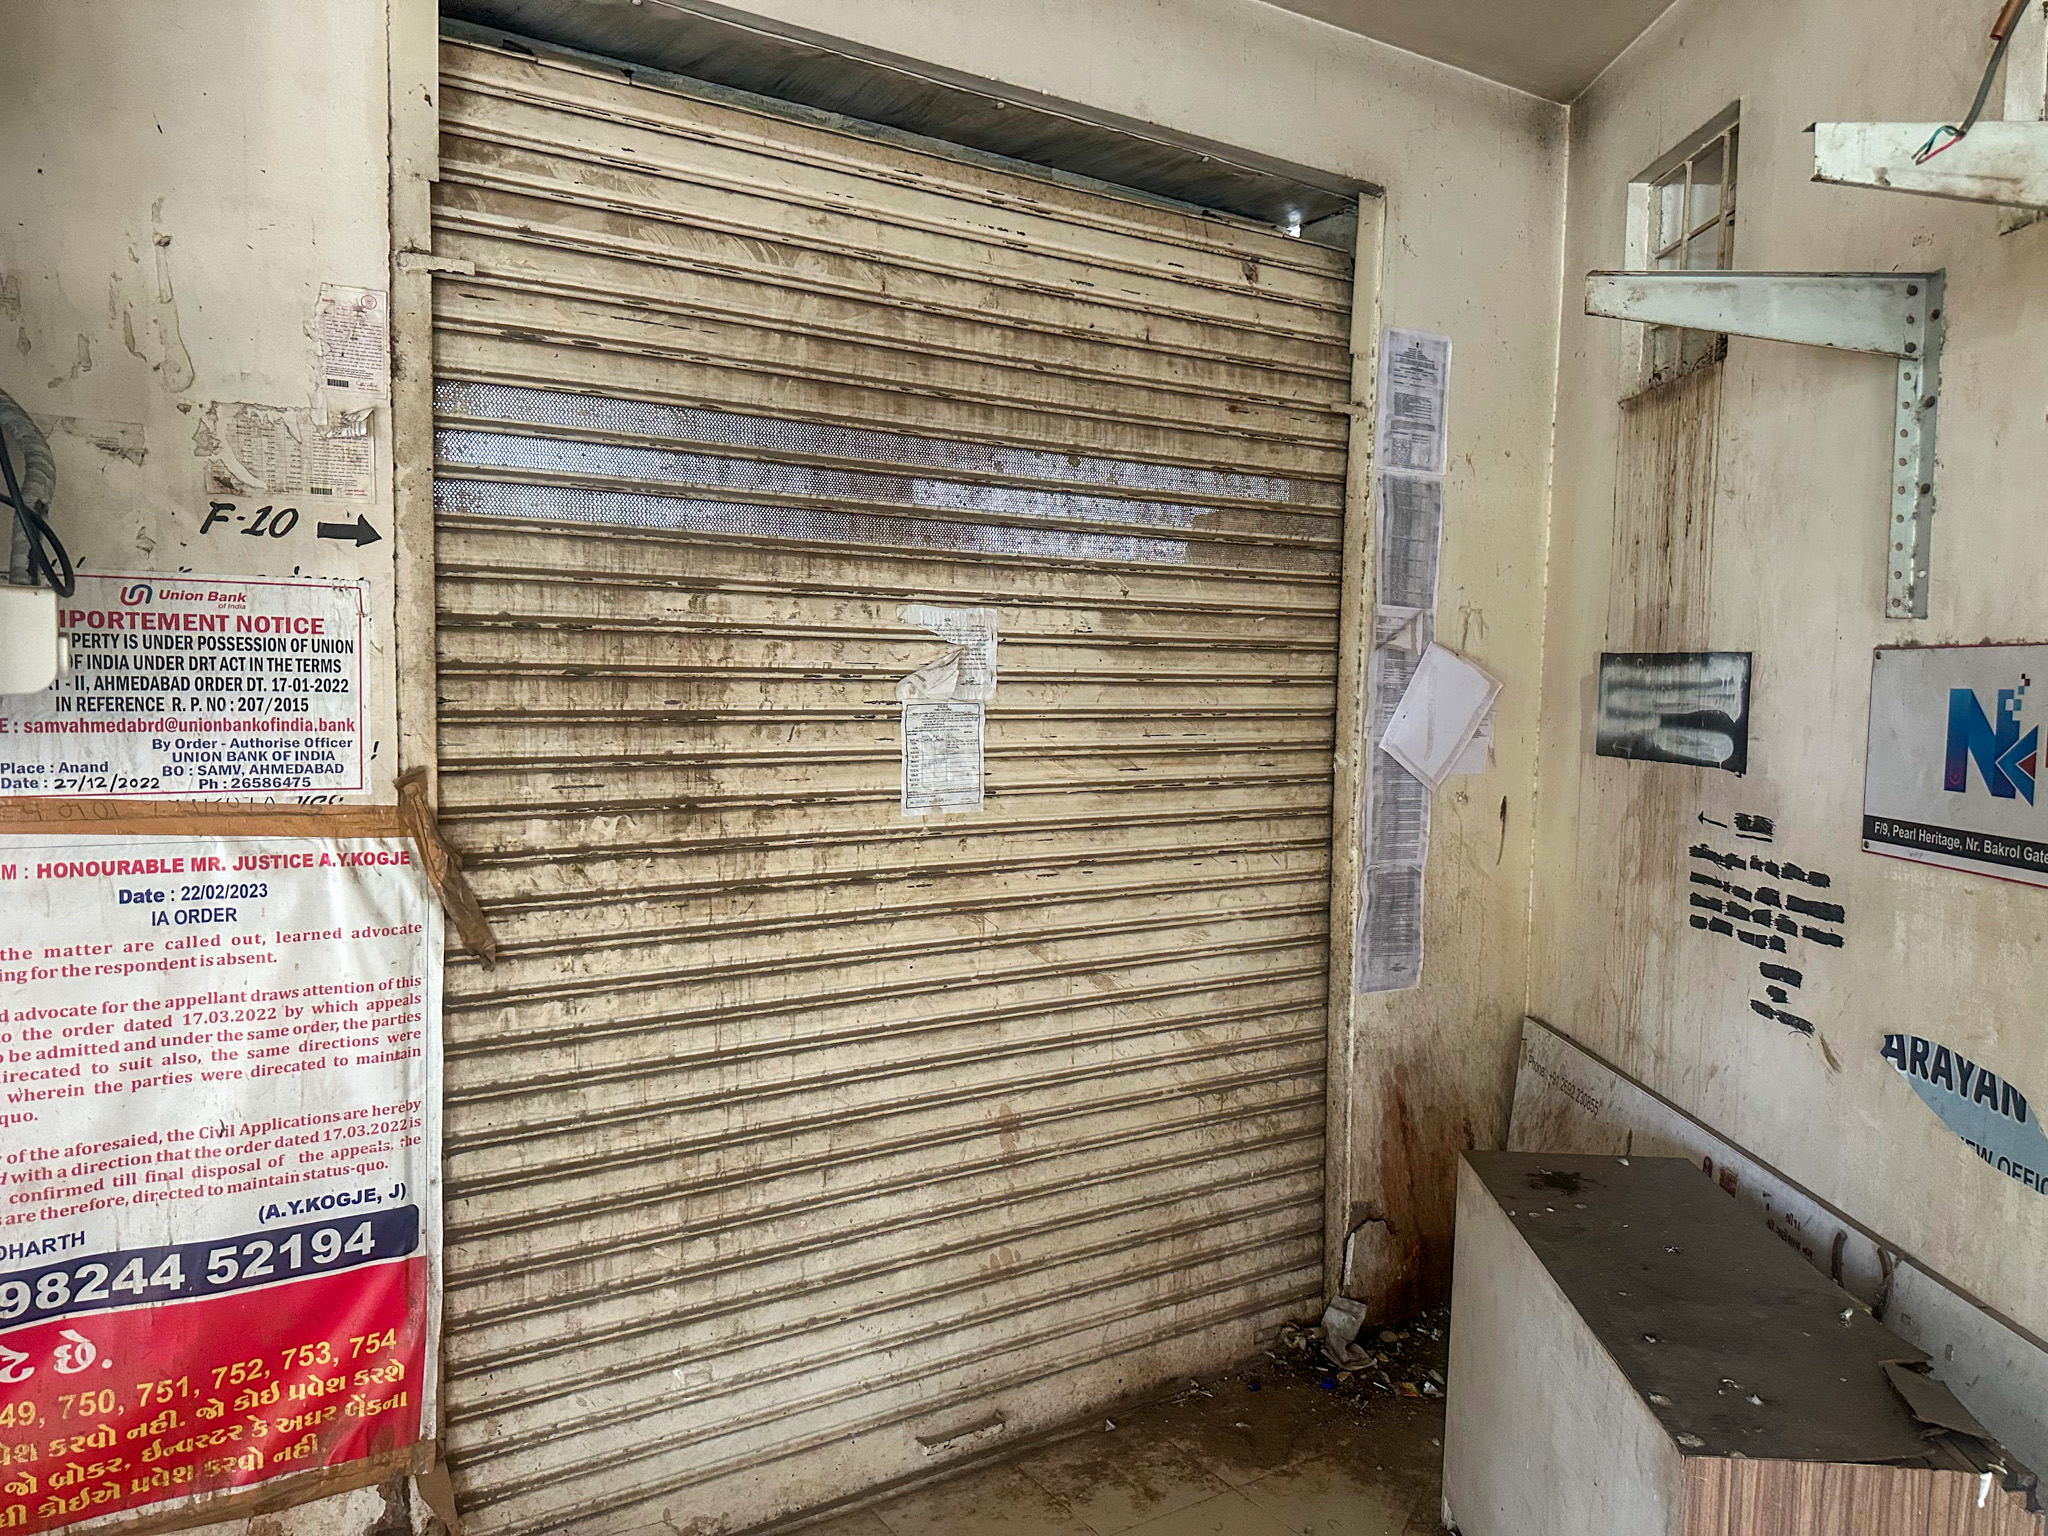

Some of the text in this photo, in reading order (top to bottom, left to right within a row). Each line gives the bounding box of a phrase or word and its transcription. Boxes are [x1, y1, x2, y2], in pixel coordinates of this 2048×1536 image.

[200, 501, 298, 538] F-10
[159, 590, 247, 602] Union Bank
[237, 615, 324, 634] NOTICE
[124, 634, 138, 649] IS
[143, 635, 193, 650] UNDER
[198, 636, 286, 651] POSSESSION
[291, 639, 308, 652] OF
[311, 639, 353, 654] UNION
[87, 655, 341, 673] INDIA UNDER DRT ACT IN THE TERMS
[94, 676, 190, 691] AHMEDABAD
[195, 678, 243, 692] ORDER
[247, 678, 266, 692] DT.
[272, 678, 349, 693] 17-01-2022
[56, 697, 308, 715] IN REFERENCE R. P. NO 207/2015
[23, 717, 355, 733] samvahmedabrd@unionbankofindia.bank
[152, 738, 352, 751] By Order Authorise Officer
[172, 751, 335, 762] UNION BANK OF INDIA
[1, 762, 108, 774] Place Anand
[163, 764, 344, 777] BO SAMV, AHMEDABAD
[1, 774, 160, 792] Date 27/12/2022
[199, 777, 311, 789] Ph 26586475
[1874, 821, 1890, 837] F/9,
[1893, 825, 1916, 840] Pearl
[1919, 829, 1962, 850] Heritage,
[1966, 837, 1980, 852] Nr.
[1984, 840, 2020, 859] Bakrol
[37, 851, 410, 879] HONOURABLE MR. JUSTICE A.Y.KOGJE
[119, 883, 268, 904] Date 22/02/2023
[152, 907, 237, 926] IA ORDER
[44, 923, 422, 959] matter are called out, learned advocate
[31, 952, 277, 980] for the respondent absent.
[14, 982, 374, 1022] advocate for appellant draws attention
[62, 993, 421, 1038] order dated 17.03.2022 which appeals
[36, 1012, 421, 1060] admitted and under same order, parties
[119, 1031, 421, 1072] suit also, same directions were
[7, 1046, 421, 1103] wherein the parties were direcated maintain
[64, 1100, 421, 1158] aforesaied, Applications hereby
[11, 1119, 407, 1183] with direction that order dated 17.03.2022
[9, 1159, 261, 1205] confirmed final disposal
[40, 1160, 388, 1221] therefore, directed maintain status-quo.
[259, 1183, 406, 1224] (A.Y.KOGJE, J)
[0, 1221, 376, 1320] 98244 52194
[54, 1329, 113, 1374] છે.
[58, 1328, 397, 1420] 750, 751, 752, 753, 754
